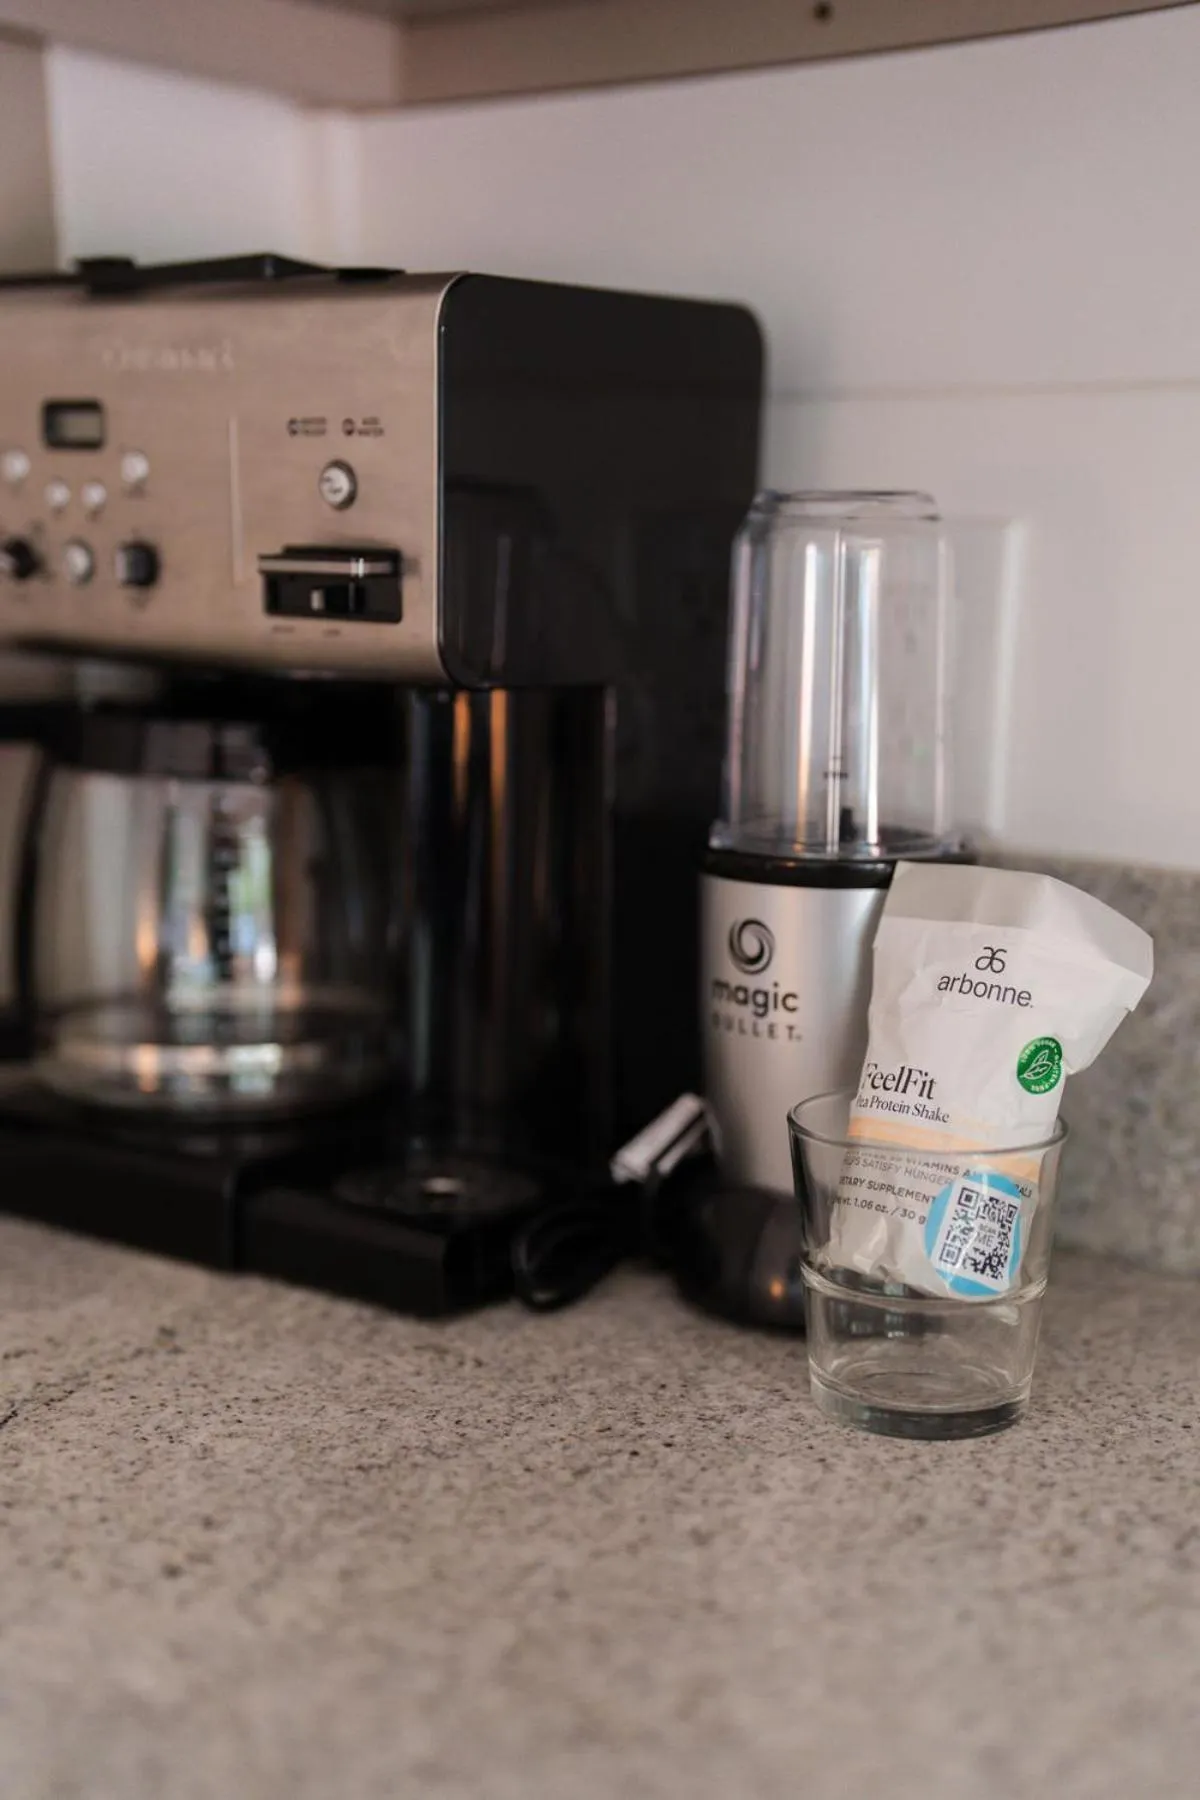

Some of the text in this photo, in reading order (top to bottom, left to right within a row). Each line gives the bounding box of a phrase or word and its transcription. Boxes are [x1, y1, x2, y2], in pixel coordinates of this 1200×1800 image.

[712, 980, 799, 1017] magic
[862, 1063, 937, 1100] FeelFit
[869, 1095, 911, 1115] Protein
[911, 1103, 950, 1123] Shake
[901, 1208, 916, 1220] 30
